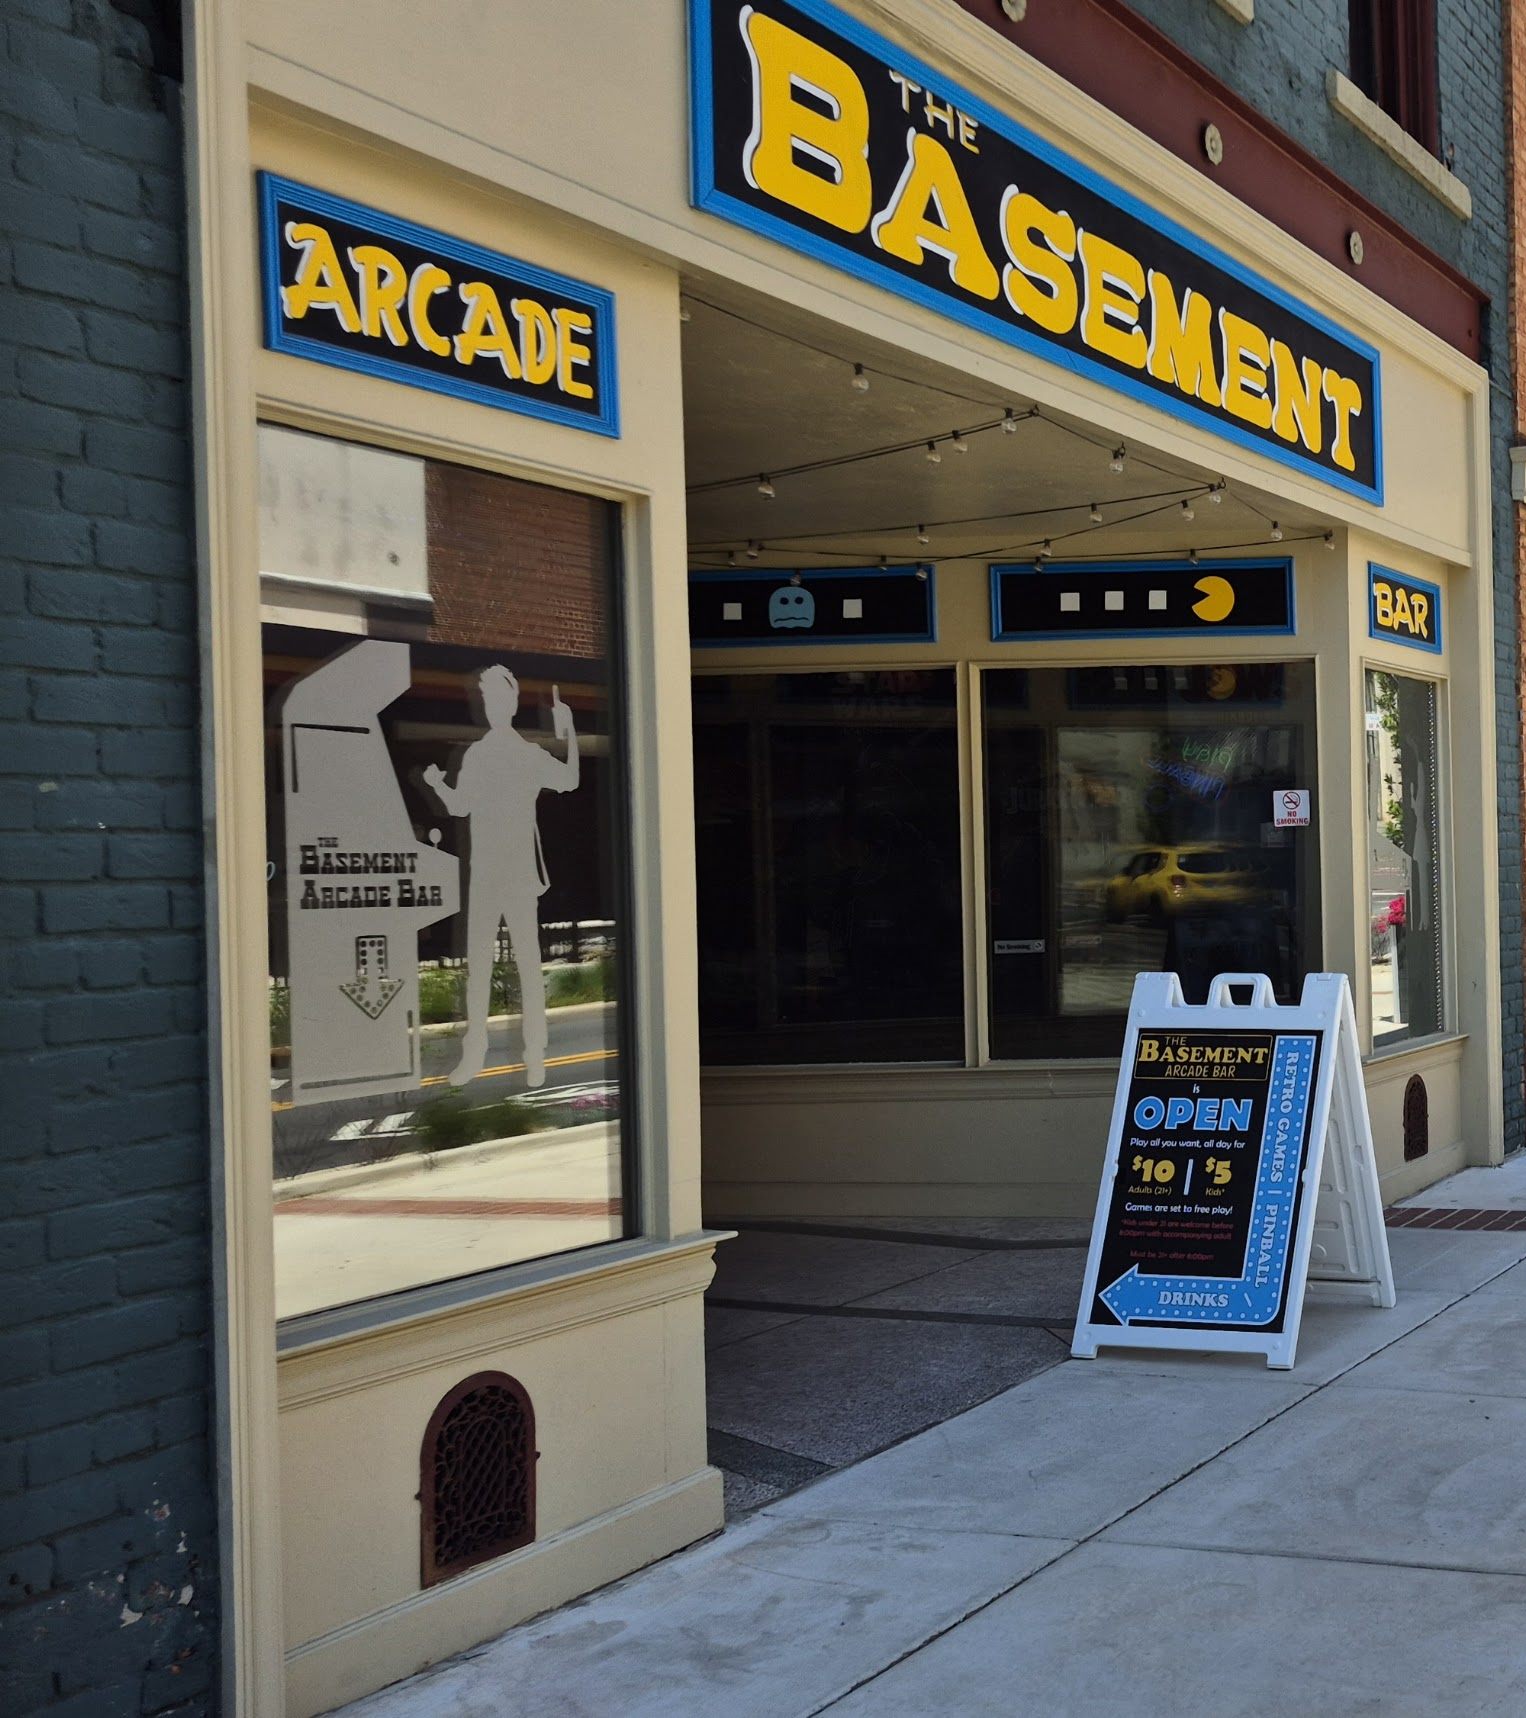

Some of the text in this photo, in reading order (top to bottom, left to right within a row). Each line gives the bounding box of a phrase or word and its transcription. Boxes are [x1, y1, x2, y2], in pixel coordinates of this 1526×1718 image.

[889, 68, 981, 155] THE
[738, 4, 1362, 472] BASEMENT
[281, 221, 594, 400] ARCADE
[1373, 581, 1429, 640] BAR
[1276, 817, 1309, 826] SMOKING
[317, 836, 339, 848] THE
[299, 844, 418, 875] BASEMENT
[300, 878, 443, 910] ARCADE BAR
[1138, 1039, 1269, 1064] BASEMENT
[1164, 1036, 1188, 1046] THE
[1164, 1064, 1236, 1078] ARCADE BAR
[1192, 1083, 1201, 1094] is
[1133, 1095, 1254, 1132] OPEN
[1130, 1138, 1149, 1148] Play
[1150, 1138, 1160, 1147] all
[1161, 1140, 1177, 1149] you
[1203, 1140, 1214, 1148] all
[1215, 1140, 1232, 1150] day
[1233, 1140, 1246, 1149] for
[1131, 1155, 1233, 1185] $10 $5
[1255, 1052, 1300, 1288] RETRO GAMES PINBALL
[1128, 1185, 1153, 1194] Adults
[1154, 1186, 1173, 1196] (21+)
[1125, 1202, 1234, 1216] Games are set to free play!
[1157, 1290, 1230, 1308] DRINKS
